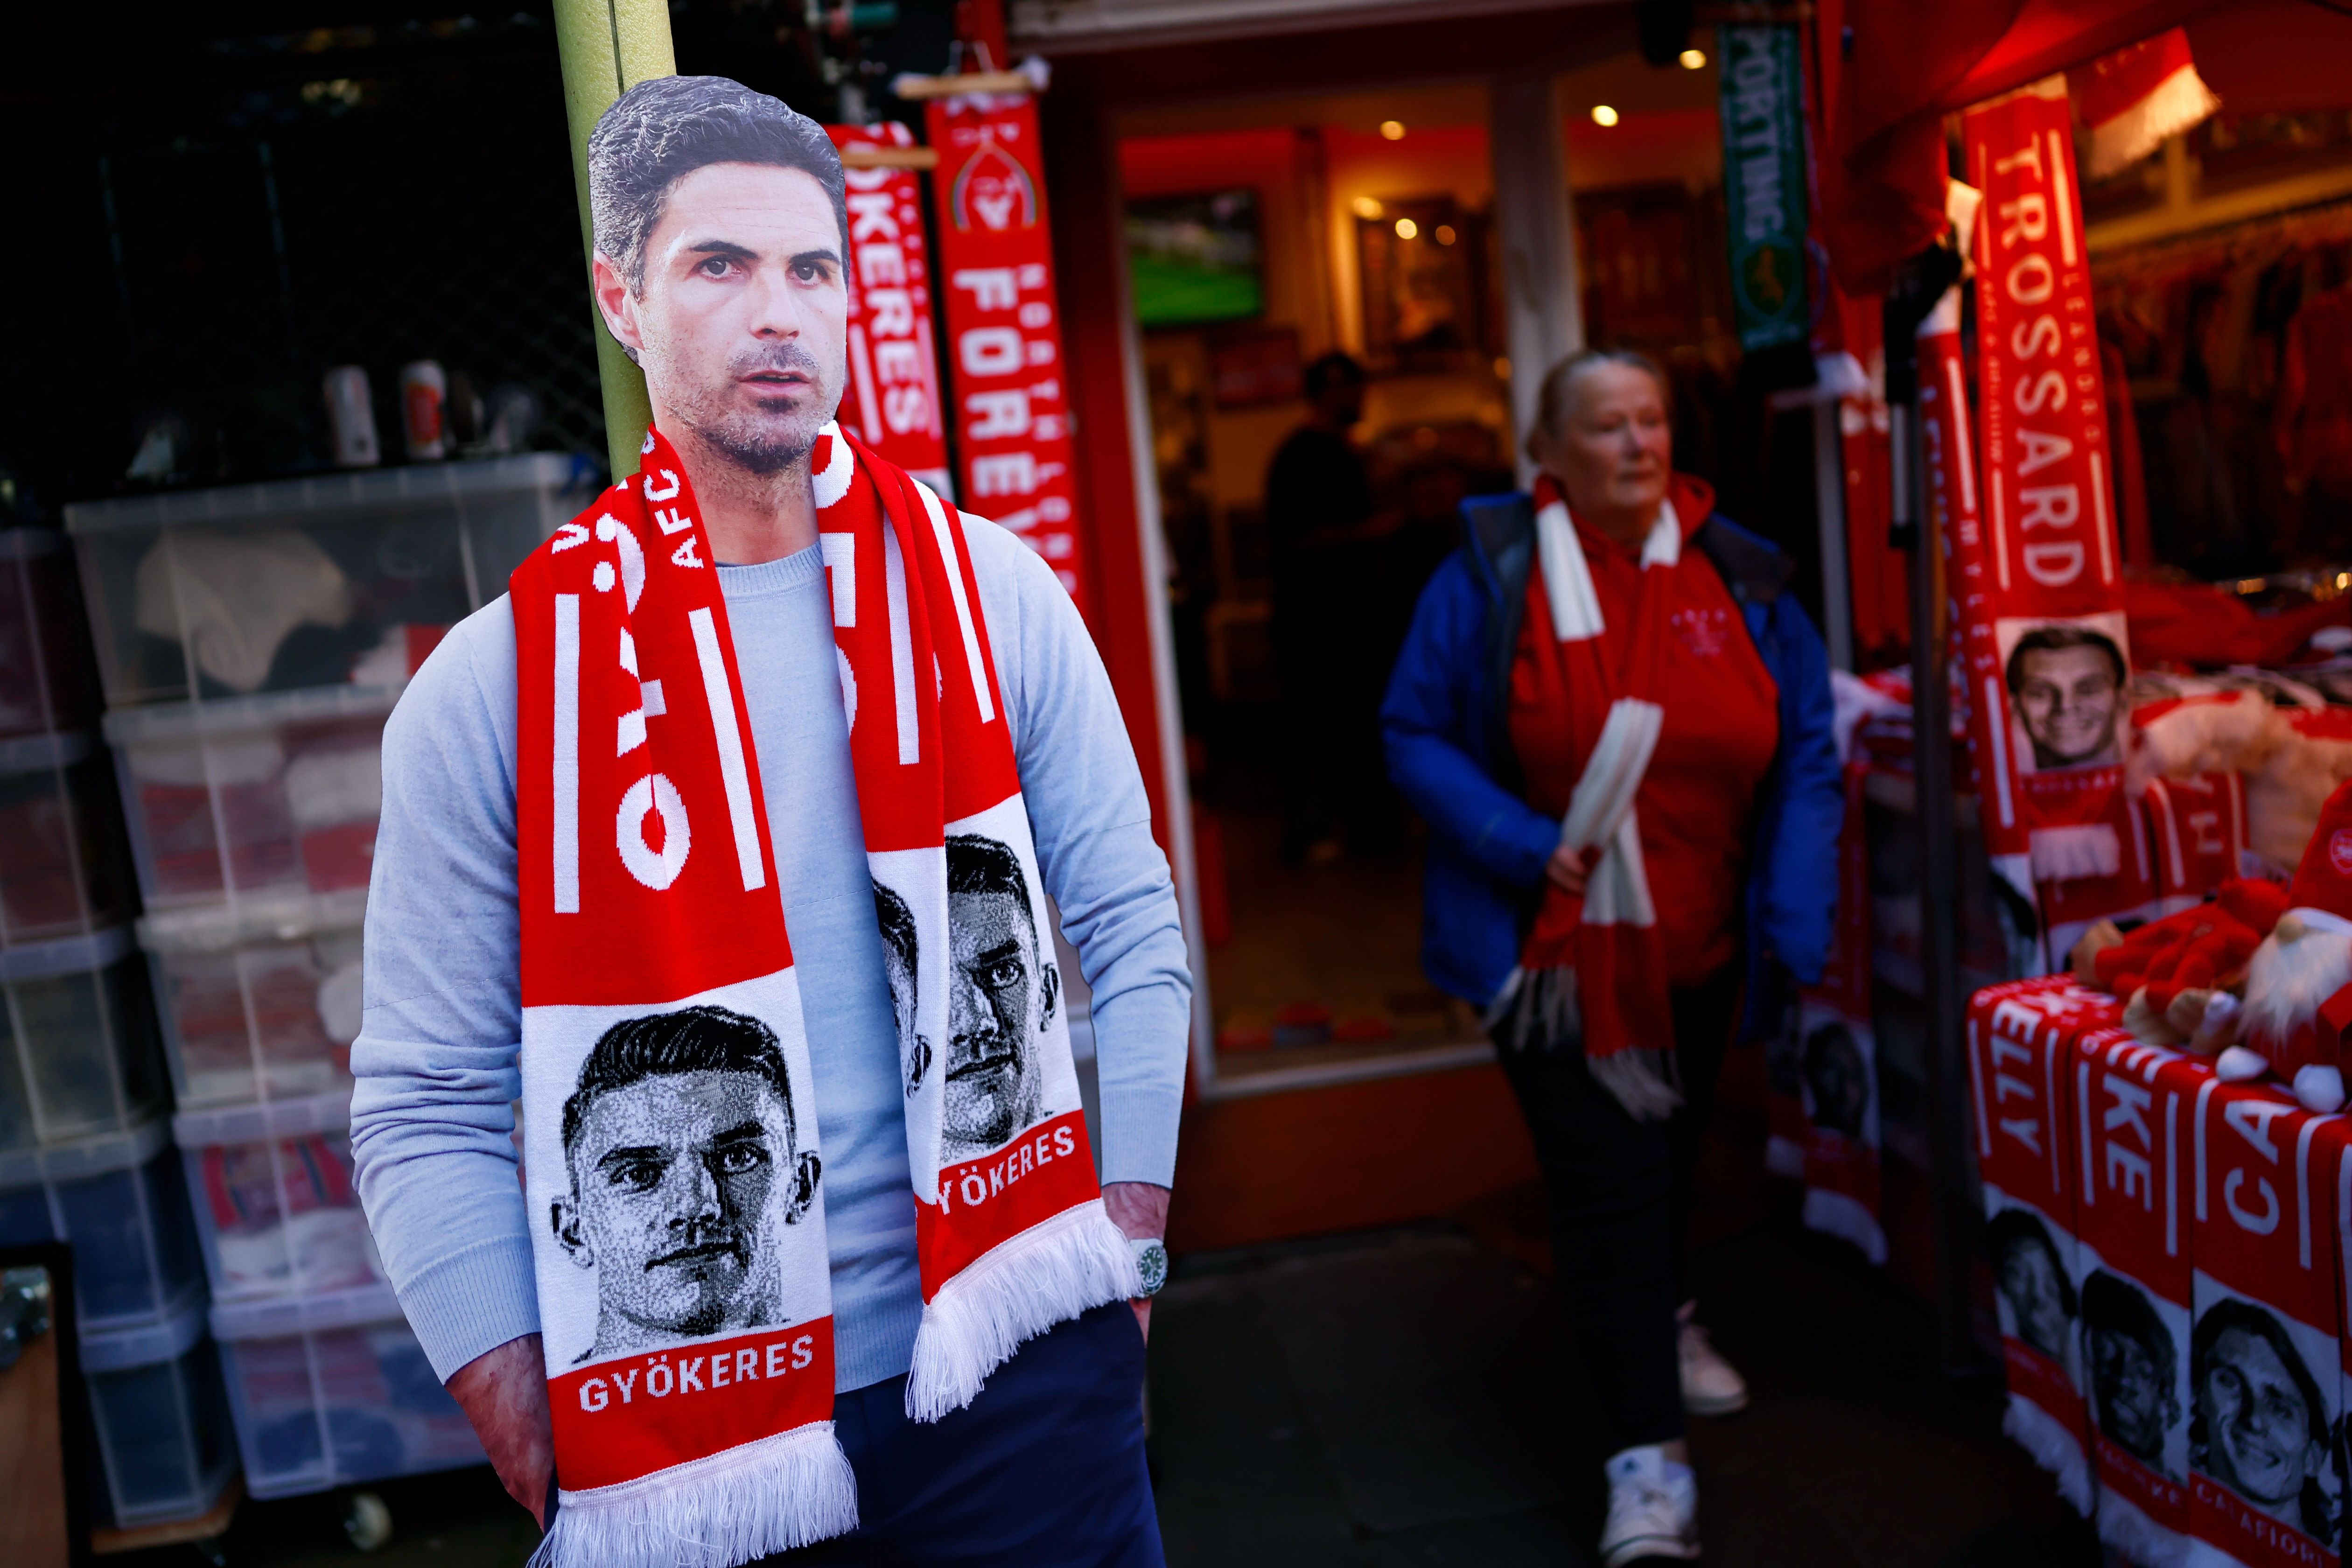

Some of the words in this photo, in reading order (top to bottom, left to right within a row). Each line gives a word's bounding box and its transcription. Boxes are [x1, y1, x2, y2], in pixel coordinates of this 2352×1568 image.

[1995, 132, 2086, 587] TROSSARD
[2062, 273, 2101, 443] LEANDRO
[643, 469, 704, 569] AFC
[1959, 518, 1997, 671] MYLES
[579, 1335, 813, 1413] GYÖKERES
